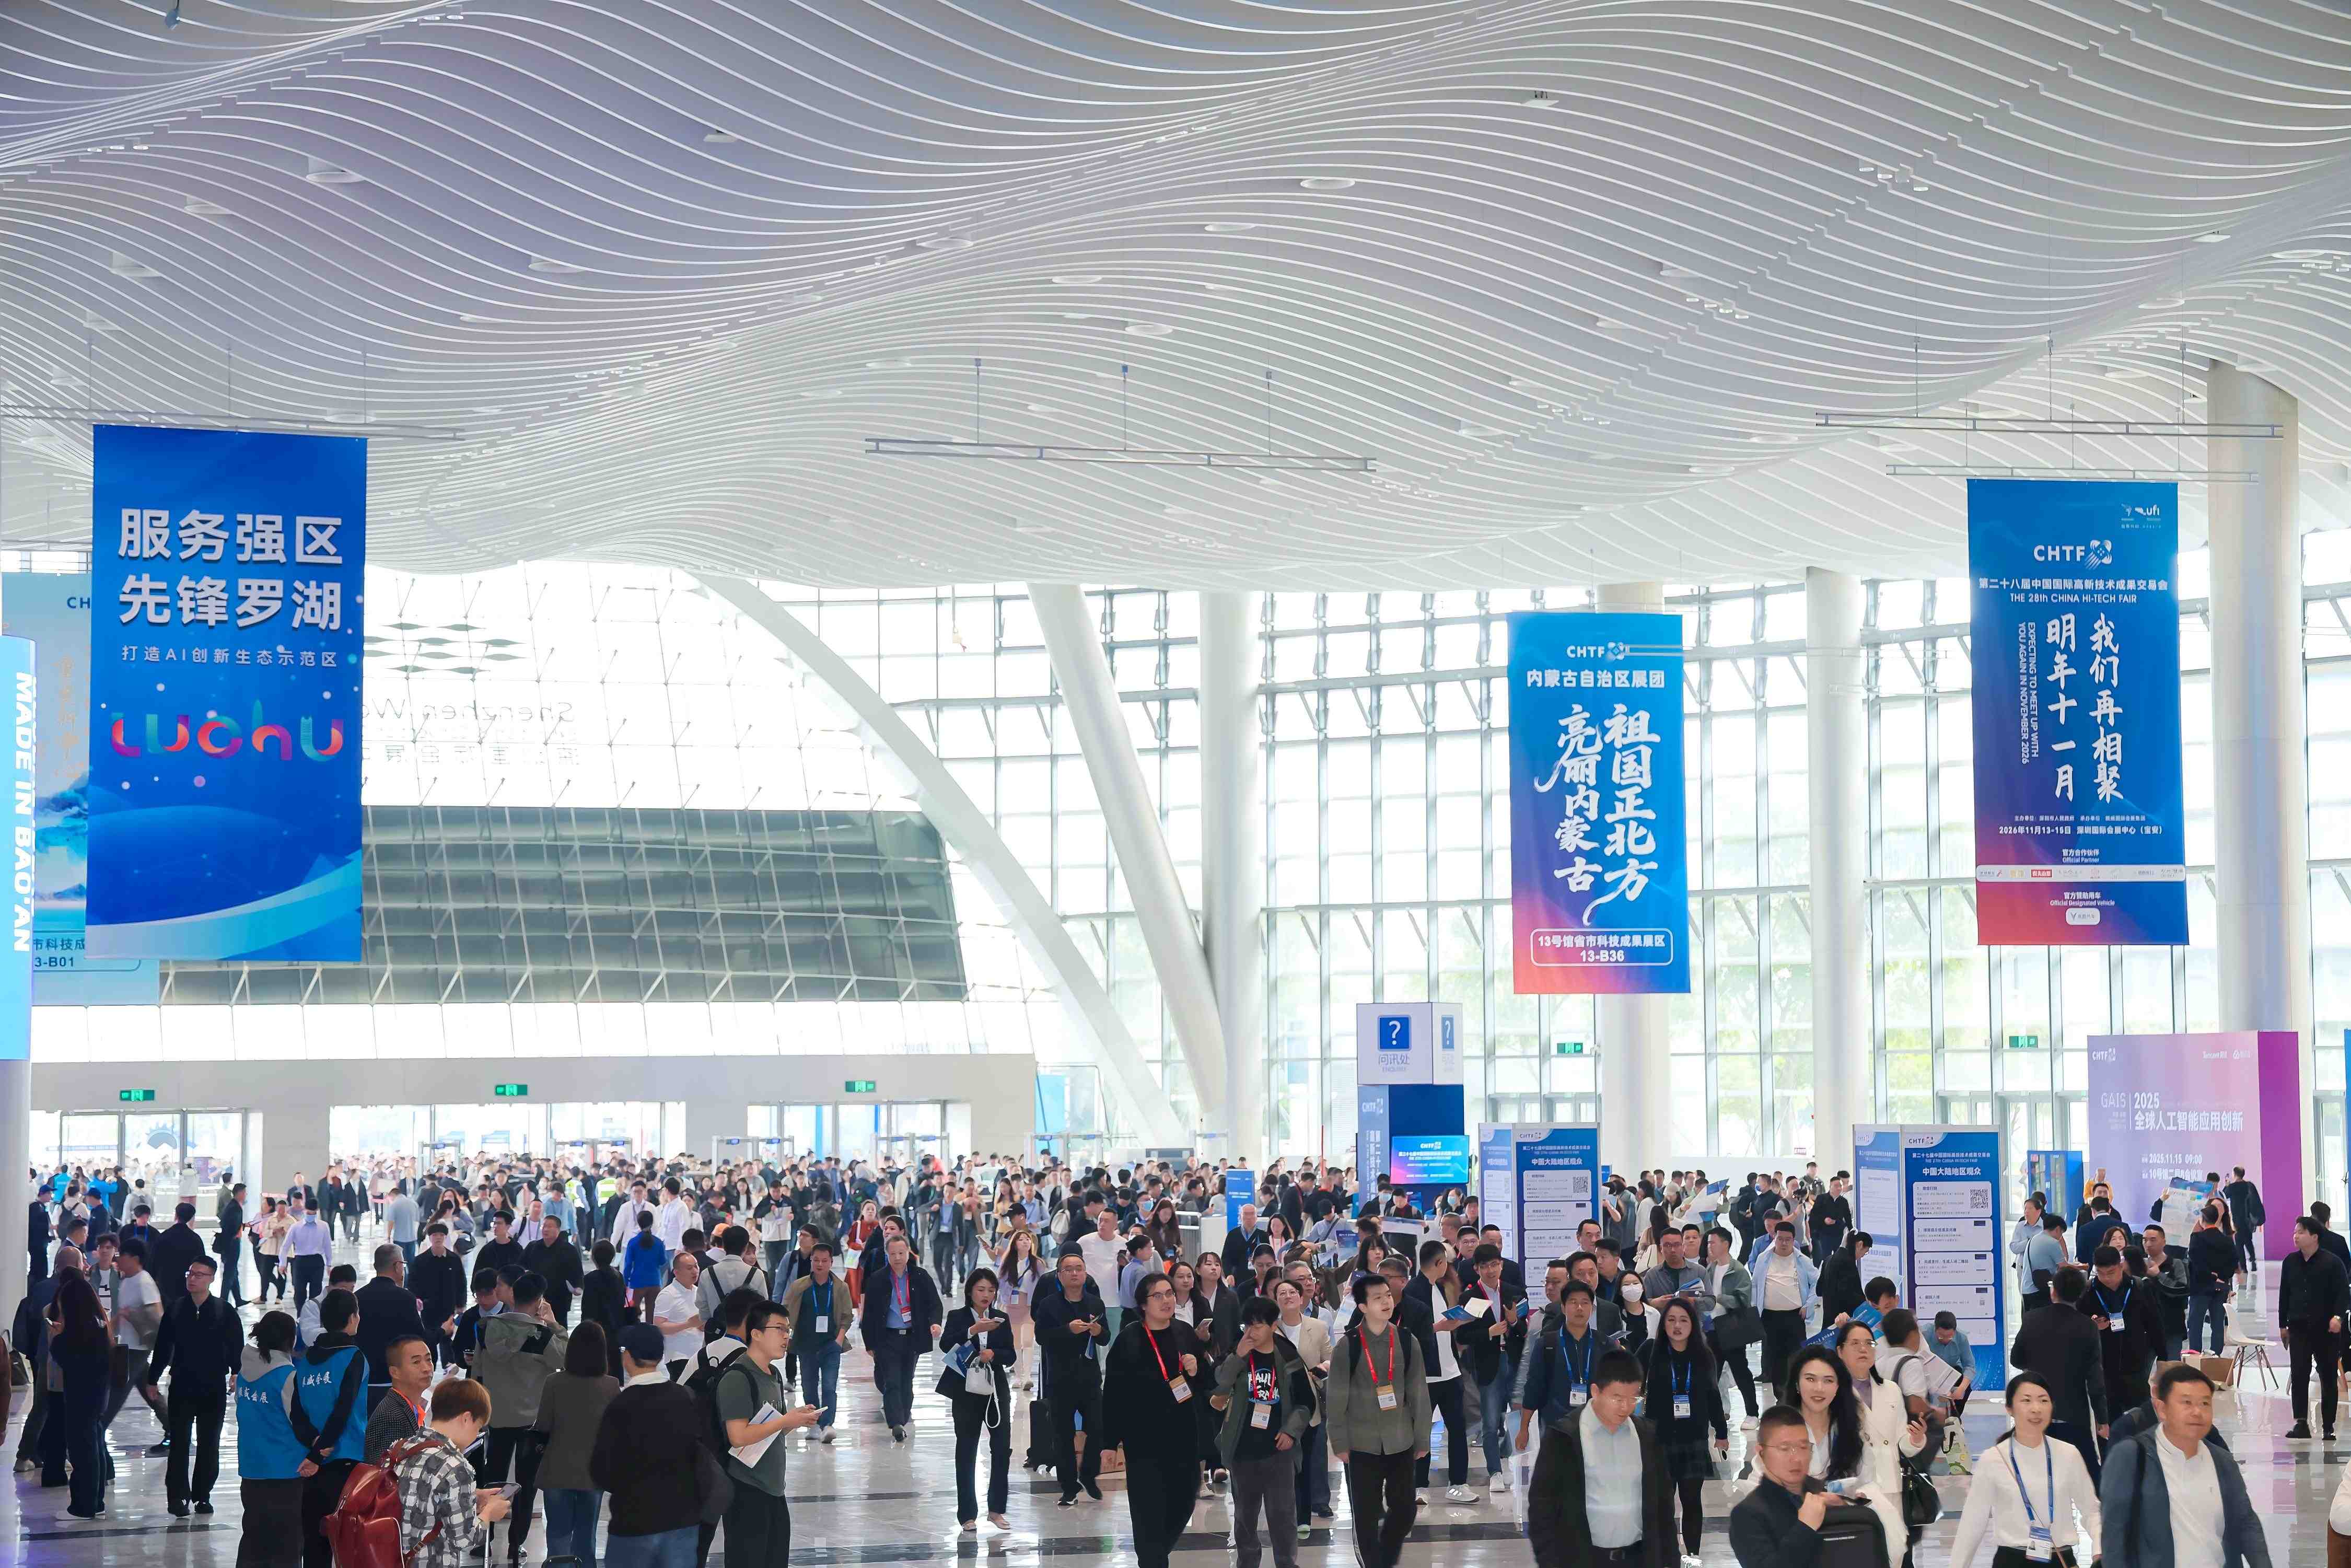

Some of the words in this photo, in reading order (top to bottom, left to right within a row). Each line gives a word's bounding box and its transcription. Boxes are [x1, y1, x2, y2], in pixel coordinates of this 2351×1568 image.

[119, 508, 343, 564] 服务强区
[2033, 545, 2086, 562] CHTF
[1978, 577, 2168, 591] 第二十八届中国国际高新技术成果交易会
[119, 573, 342, 630] 先锋罗湖
[2010, 593, 2025, 602] THE
[2051, 594, 2080, 603] CHINA
[2082, 594, 2116, 603] HI-TECH
[2119, 594, 2137, 603] FAIR
[121, 645, 337, 667] 打造AI创新生态示范区
[1566, 645, 1605, 658] CHTF
[2028, 622, 2036, 674] EXPECTING
[1527, 669, 1665, 688] 内蒙古自治区展团
[2020, 675, 2028, 686] IN
[2029, 675, 2037, 689] TO
[2020, 687, 2029, 740] NOVEMBER
[2046, 613, 2077, 802] 明年十一月
[2090, 612, 2124, 804] 我们再相聚
[15, 672, 32, 772] MADE
[2030, 717, 2038, 731] UP
[2021, 740, 2030, 764] 2026
[15, 781, 32, 815] IN
[1582, 703, 1662, 926] 祖国正北方
[14, 826, 32, 951] BAO'AN
[1580, 950, 1625, 962] 13-B36
[1378, 1053, 1410, 1066] 问讯处
[2101, 1092, 2126, 1108] GAIS
[2134, 1091, 2160, 1109] 2025
[2134, 1110, 2243, 1132] 全球人工智能应用创新
[1922, 1167, 1982, 1176] 中国大陆地区观众
